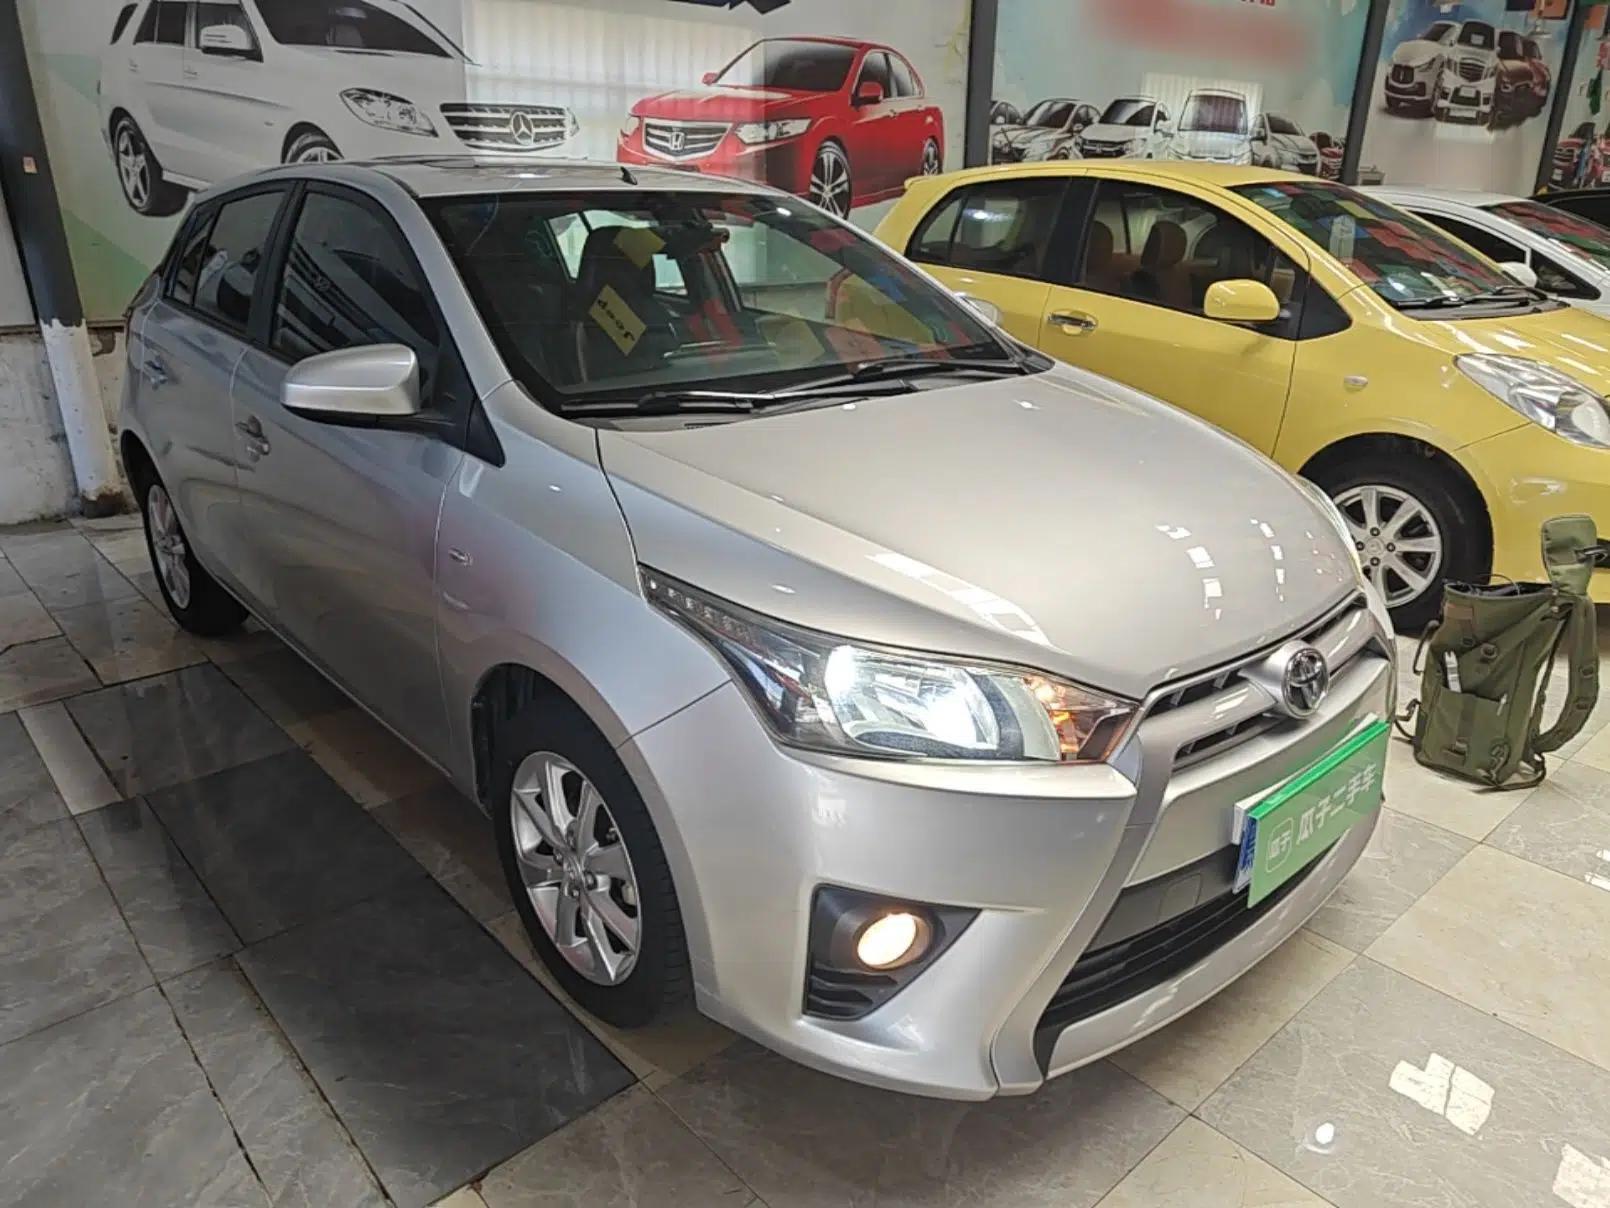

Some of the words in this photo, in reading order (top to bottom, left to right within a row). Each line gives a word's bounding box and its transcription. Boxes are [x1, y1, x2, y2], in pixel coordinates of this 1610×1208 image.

[1296, 763, 1377, 846] 瓜子二手车
